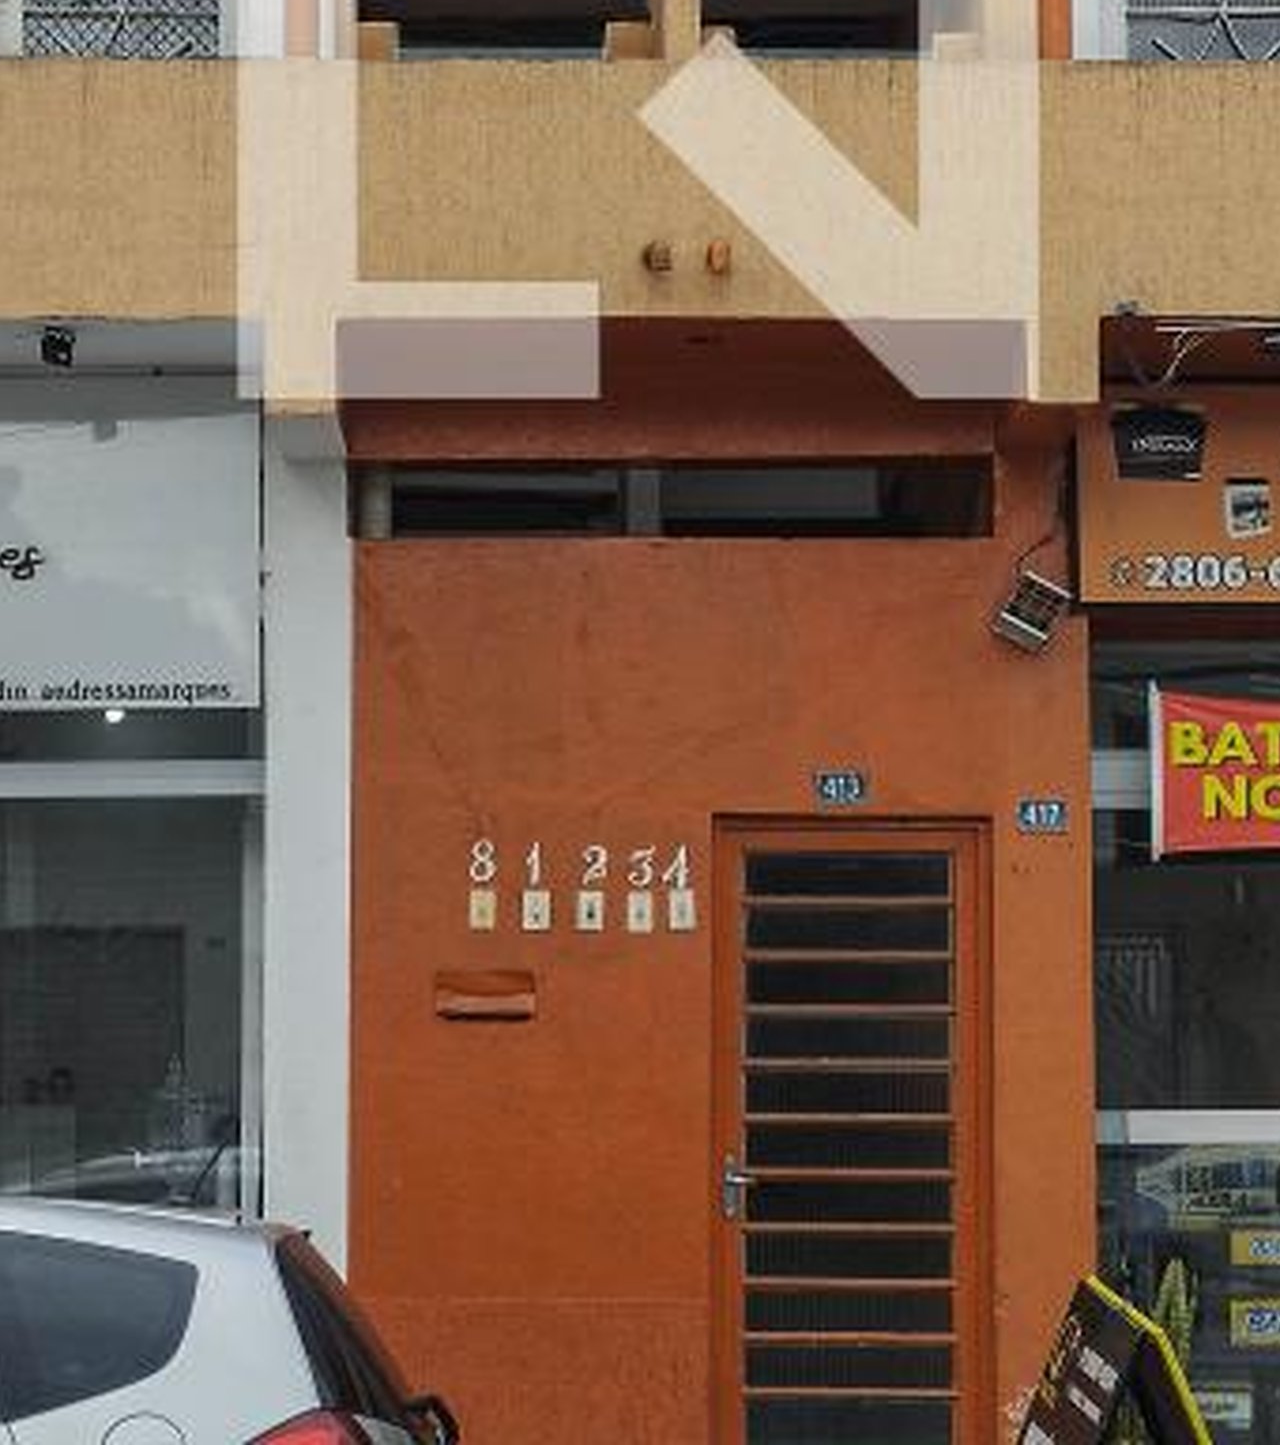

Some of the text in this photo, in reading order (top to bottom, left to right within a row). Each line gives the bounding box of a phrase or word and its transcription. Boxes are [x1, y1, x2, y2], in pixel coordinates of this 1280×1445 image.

[1021, 803, 1059, 826] 417
[525, 841, 542, 885] 1
[662, 843, 690, 890] 4
